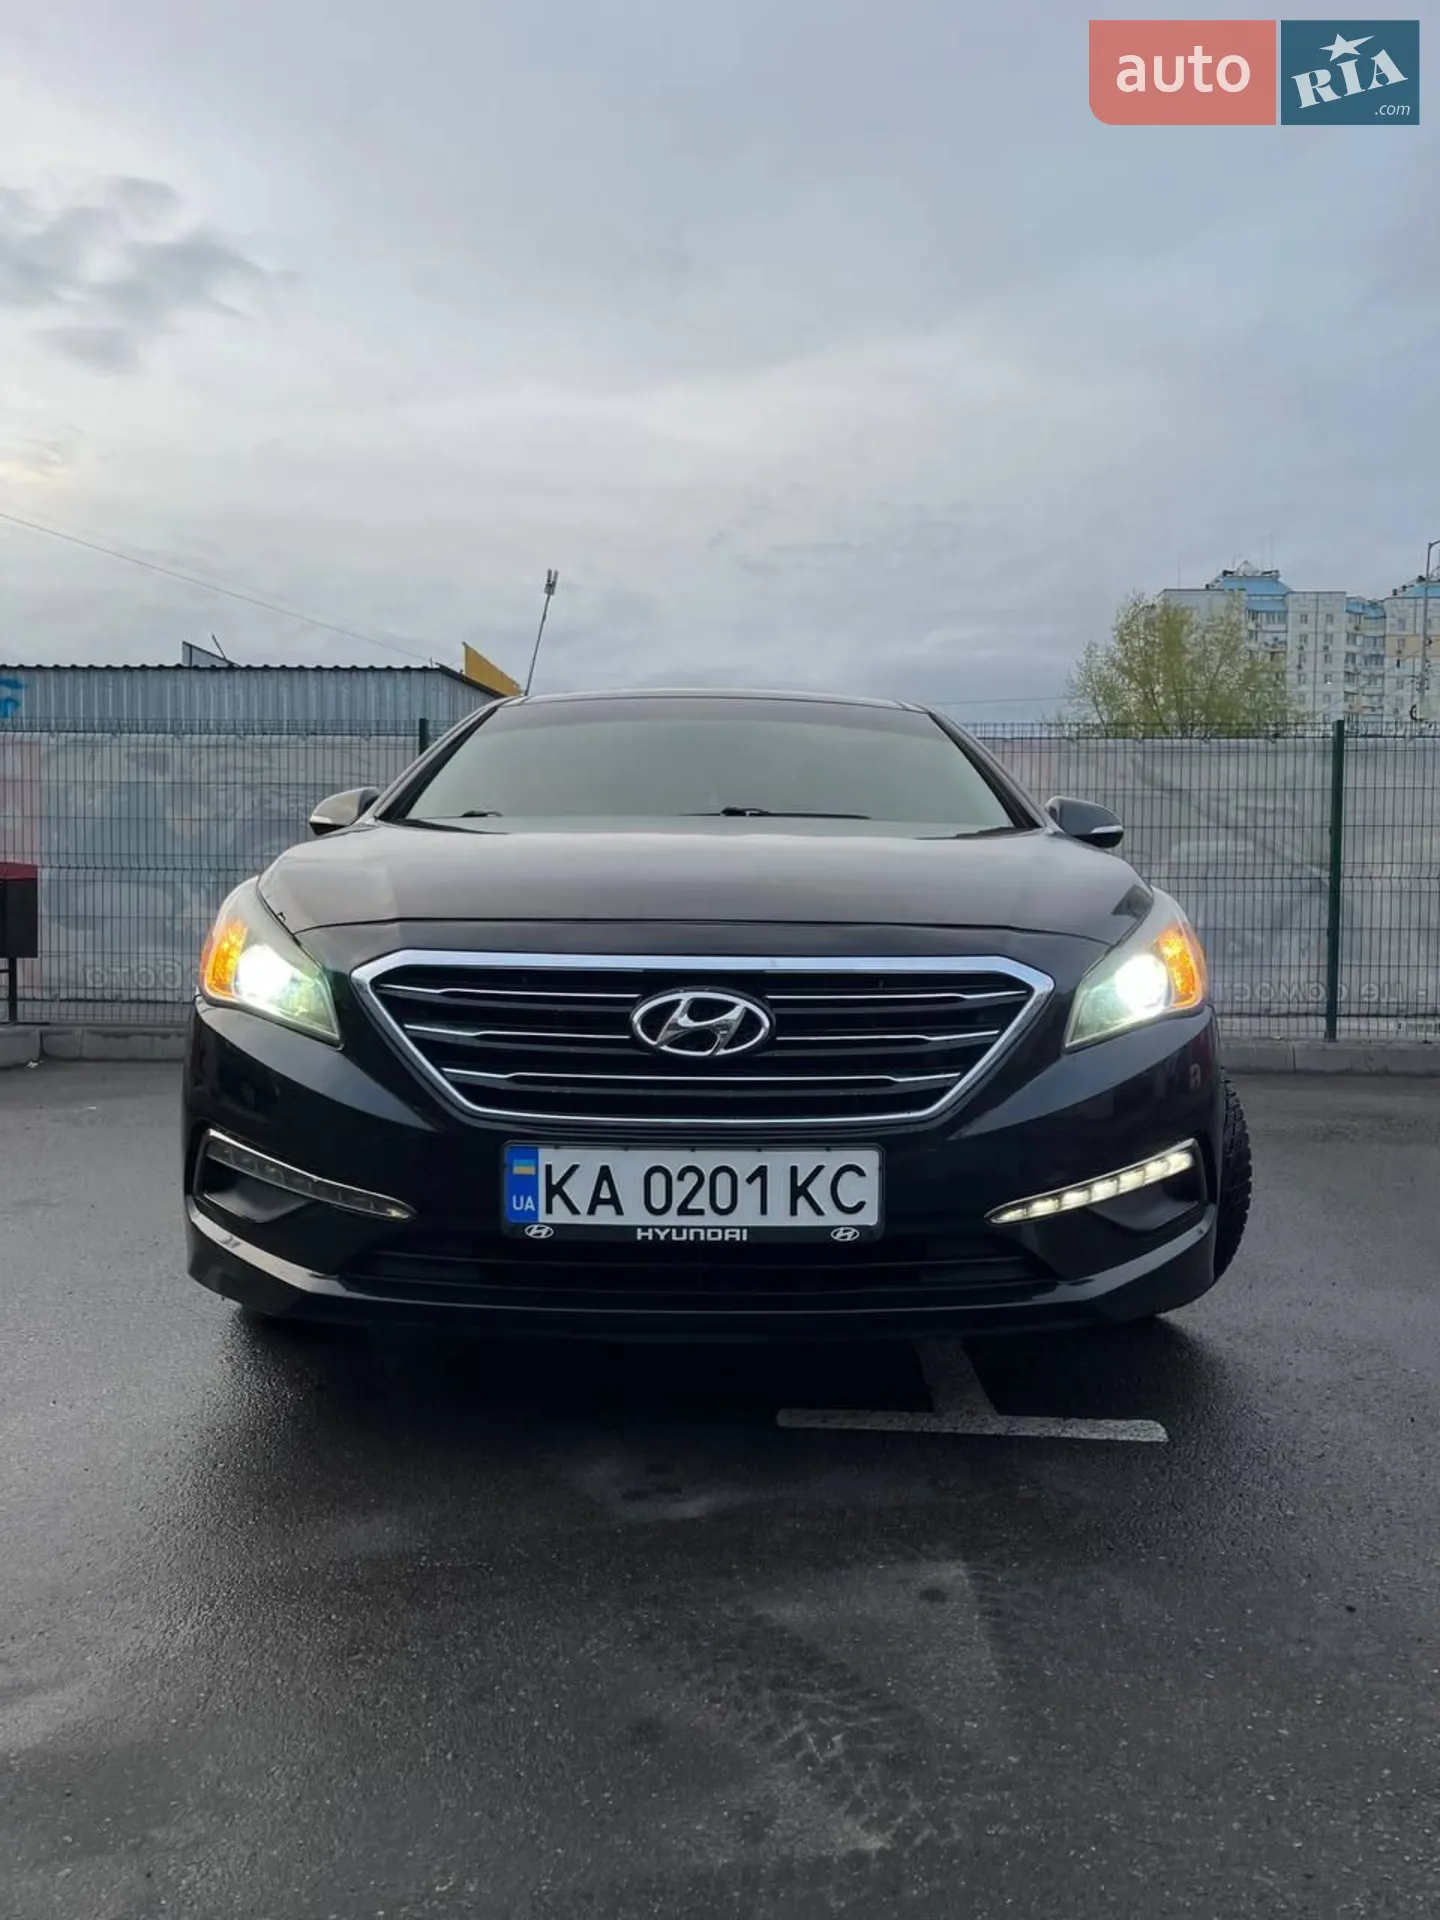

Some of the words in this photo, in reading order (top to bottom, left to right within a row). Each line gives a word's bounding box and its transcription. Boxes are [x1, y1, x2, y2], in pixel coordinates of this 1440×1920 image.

[545, 1163, 625, 1216] KA
[643, 1164, 769, 1217] 0201
[789, 1163, 867, 1216] KC
[512, 1194, 536, 1212] UA
[636, 1227, 748, 1242] HYUNDAI
